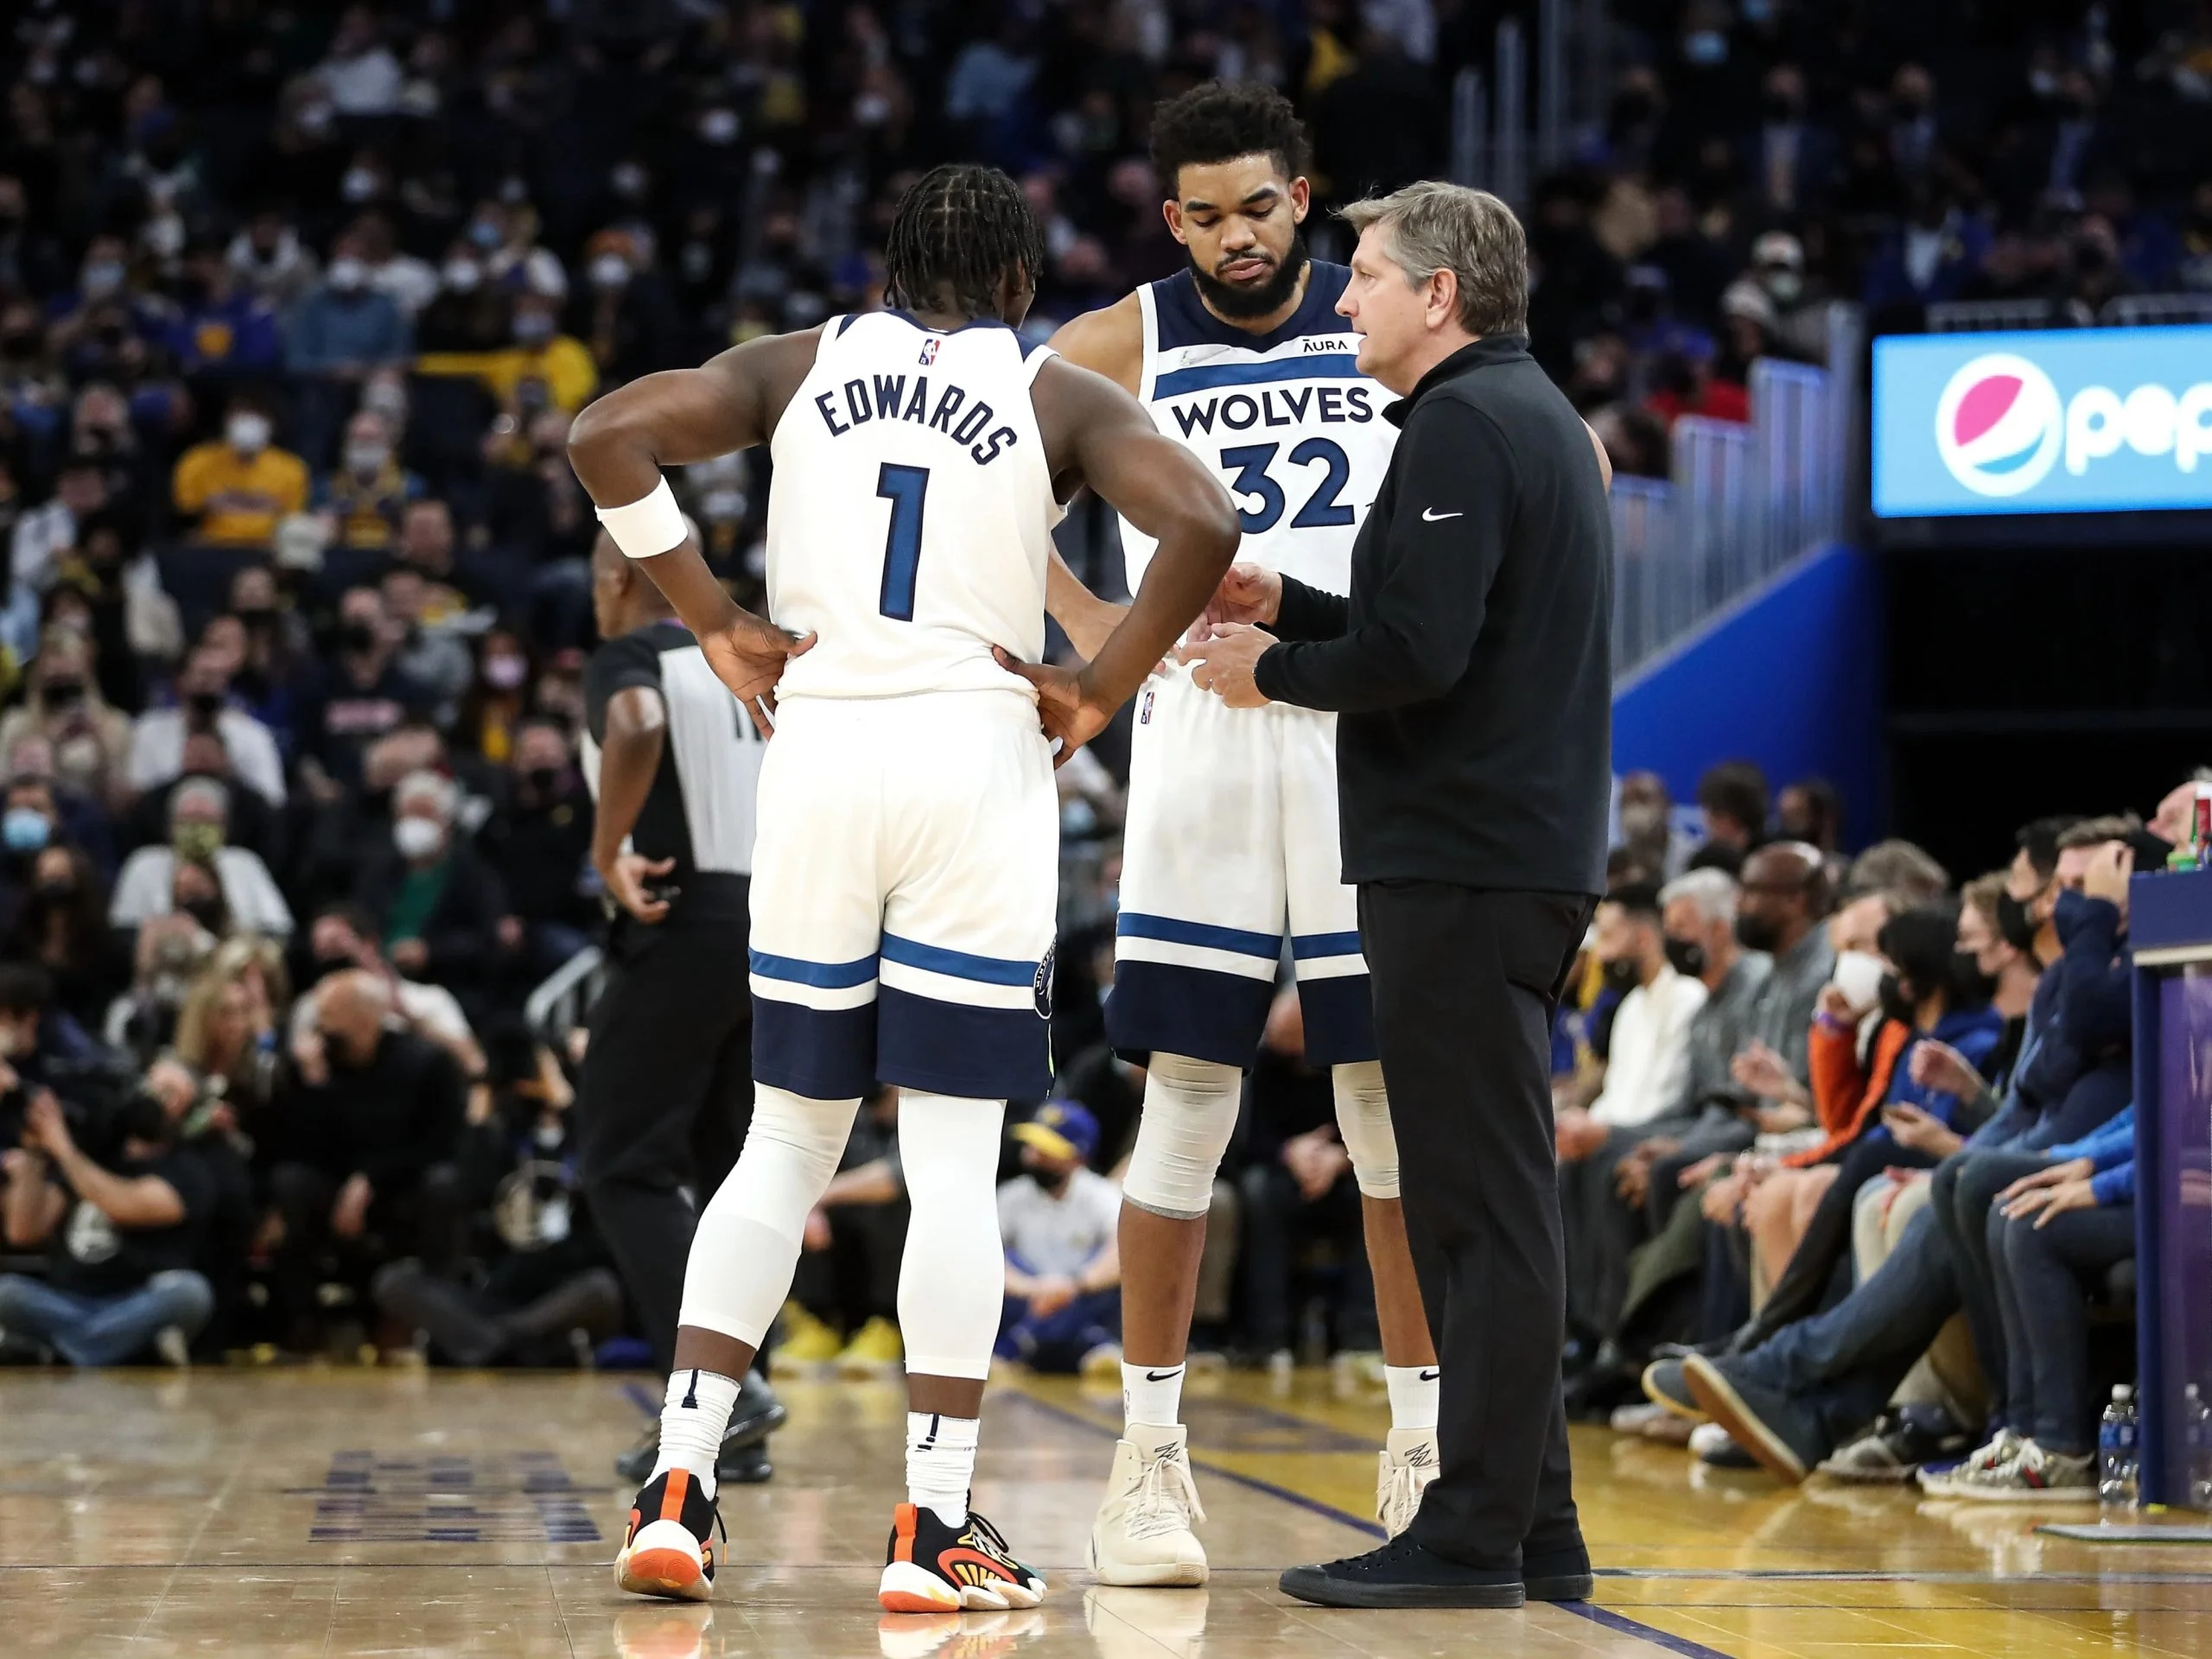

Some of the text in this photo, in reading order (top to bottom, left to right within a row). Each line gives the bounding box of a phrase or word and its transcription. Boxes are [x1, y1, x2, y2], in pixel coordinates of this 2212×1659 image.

[815, 374, 1018, 466] EDWARDS
[1171, 386, 1374, 439] WOLVES
[1219, 436, 1356, 535] 32
[875, 461, 931, 623] 1
